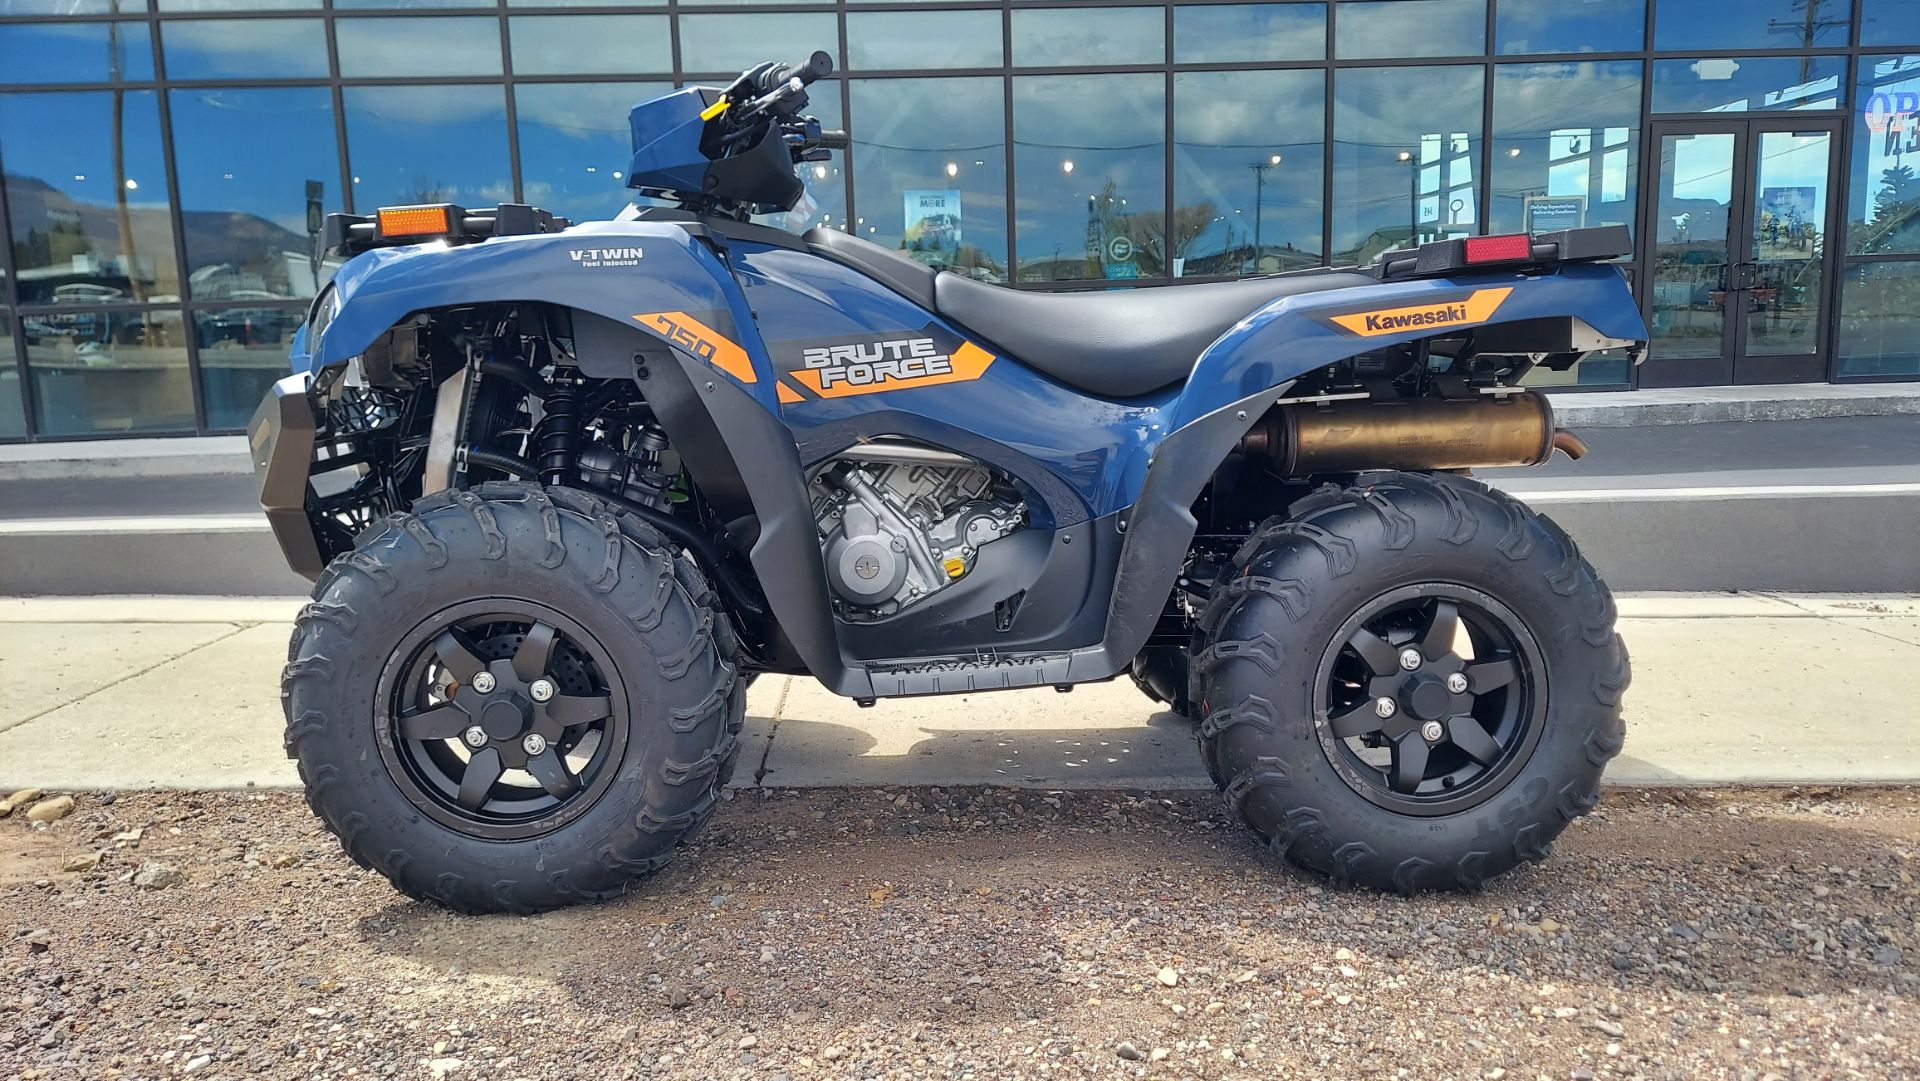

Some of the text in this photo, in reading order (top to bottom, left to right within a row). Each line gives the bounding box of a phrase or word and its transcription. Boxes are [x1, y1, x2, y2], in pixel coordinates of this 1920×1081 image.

[569, 247, 643, 261] V-TWIN
[1365, 305, 1467, 331] Kawasaki
[657, 315, 716, 366] 750
[803, 337, 935, 370] BRUTE
[819, 353, 952, 390] FORCE
